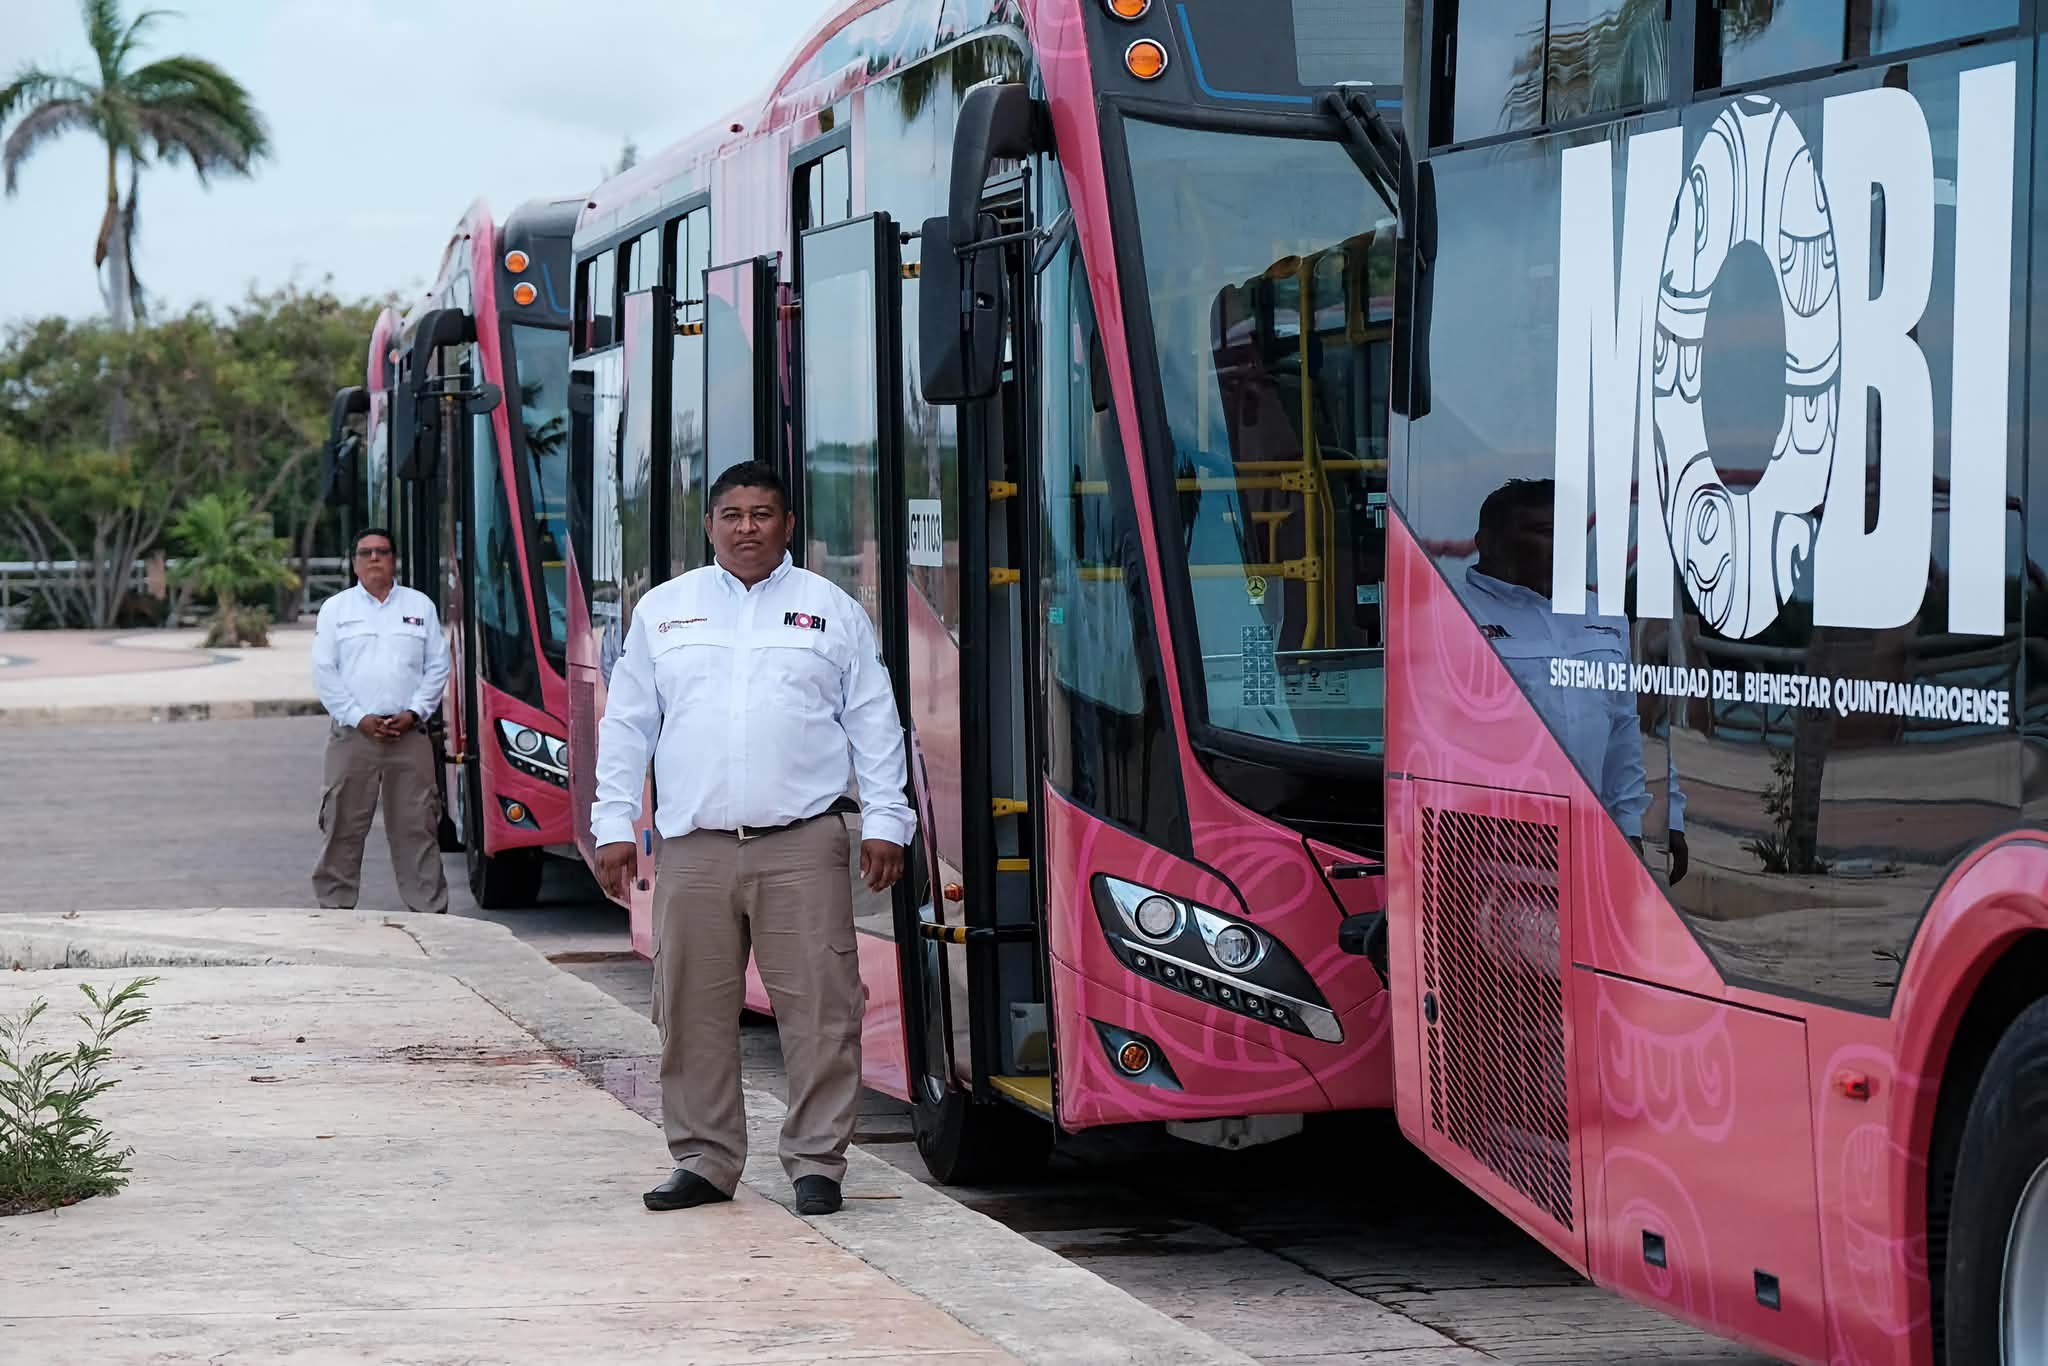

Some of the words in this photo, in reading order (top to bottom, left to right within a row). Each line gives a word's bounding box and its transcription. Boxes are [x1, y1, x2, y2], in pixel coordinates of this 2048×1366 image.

[1552, 61, 2016, 639] MOBI
[910, 513, 920, 551] GT
[922, 513, 941, 552] 1103
[784, 612, 826, 632] MOBI
[1550, 658, 1605, 689] SISTEMA
[1608, 662, 1627, 691] DE
[1629, 663, 1709, 698] MOVILIDAD
[1712, 669, 1741, 701] DEL
[1744, 672, 1831, 709] BIENESTAR
[1834, 678, 2010, 726] QUINTANARROENSE
